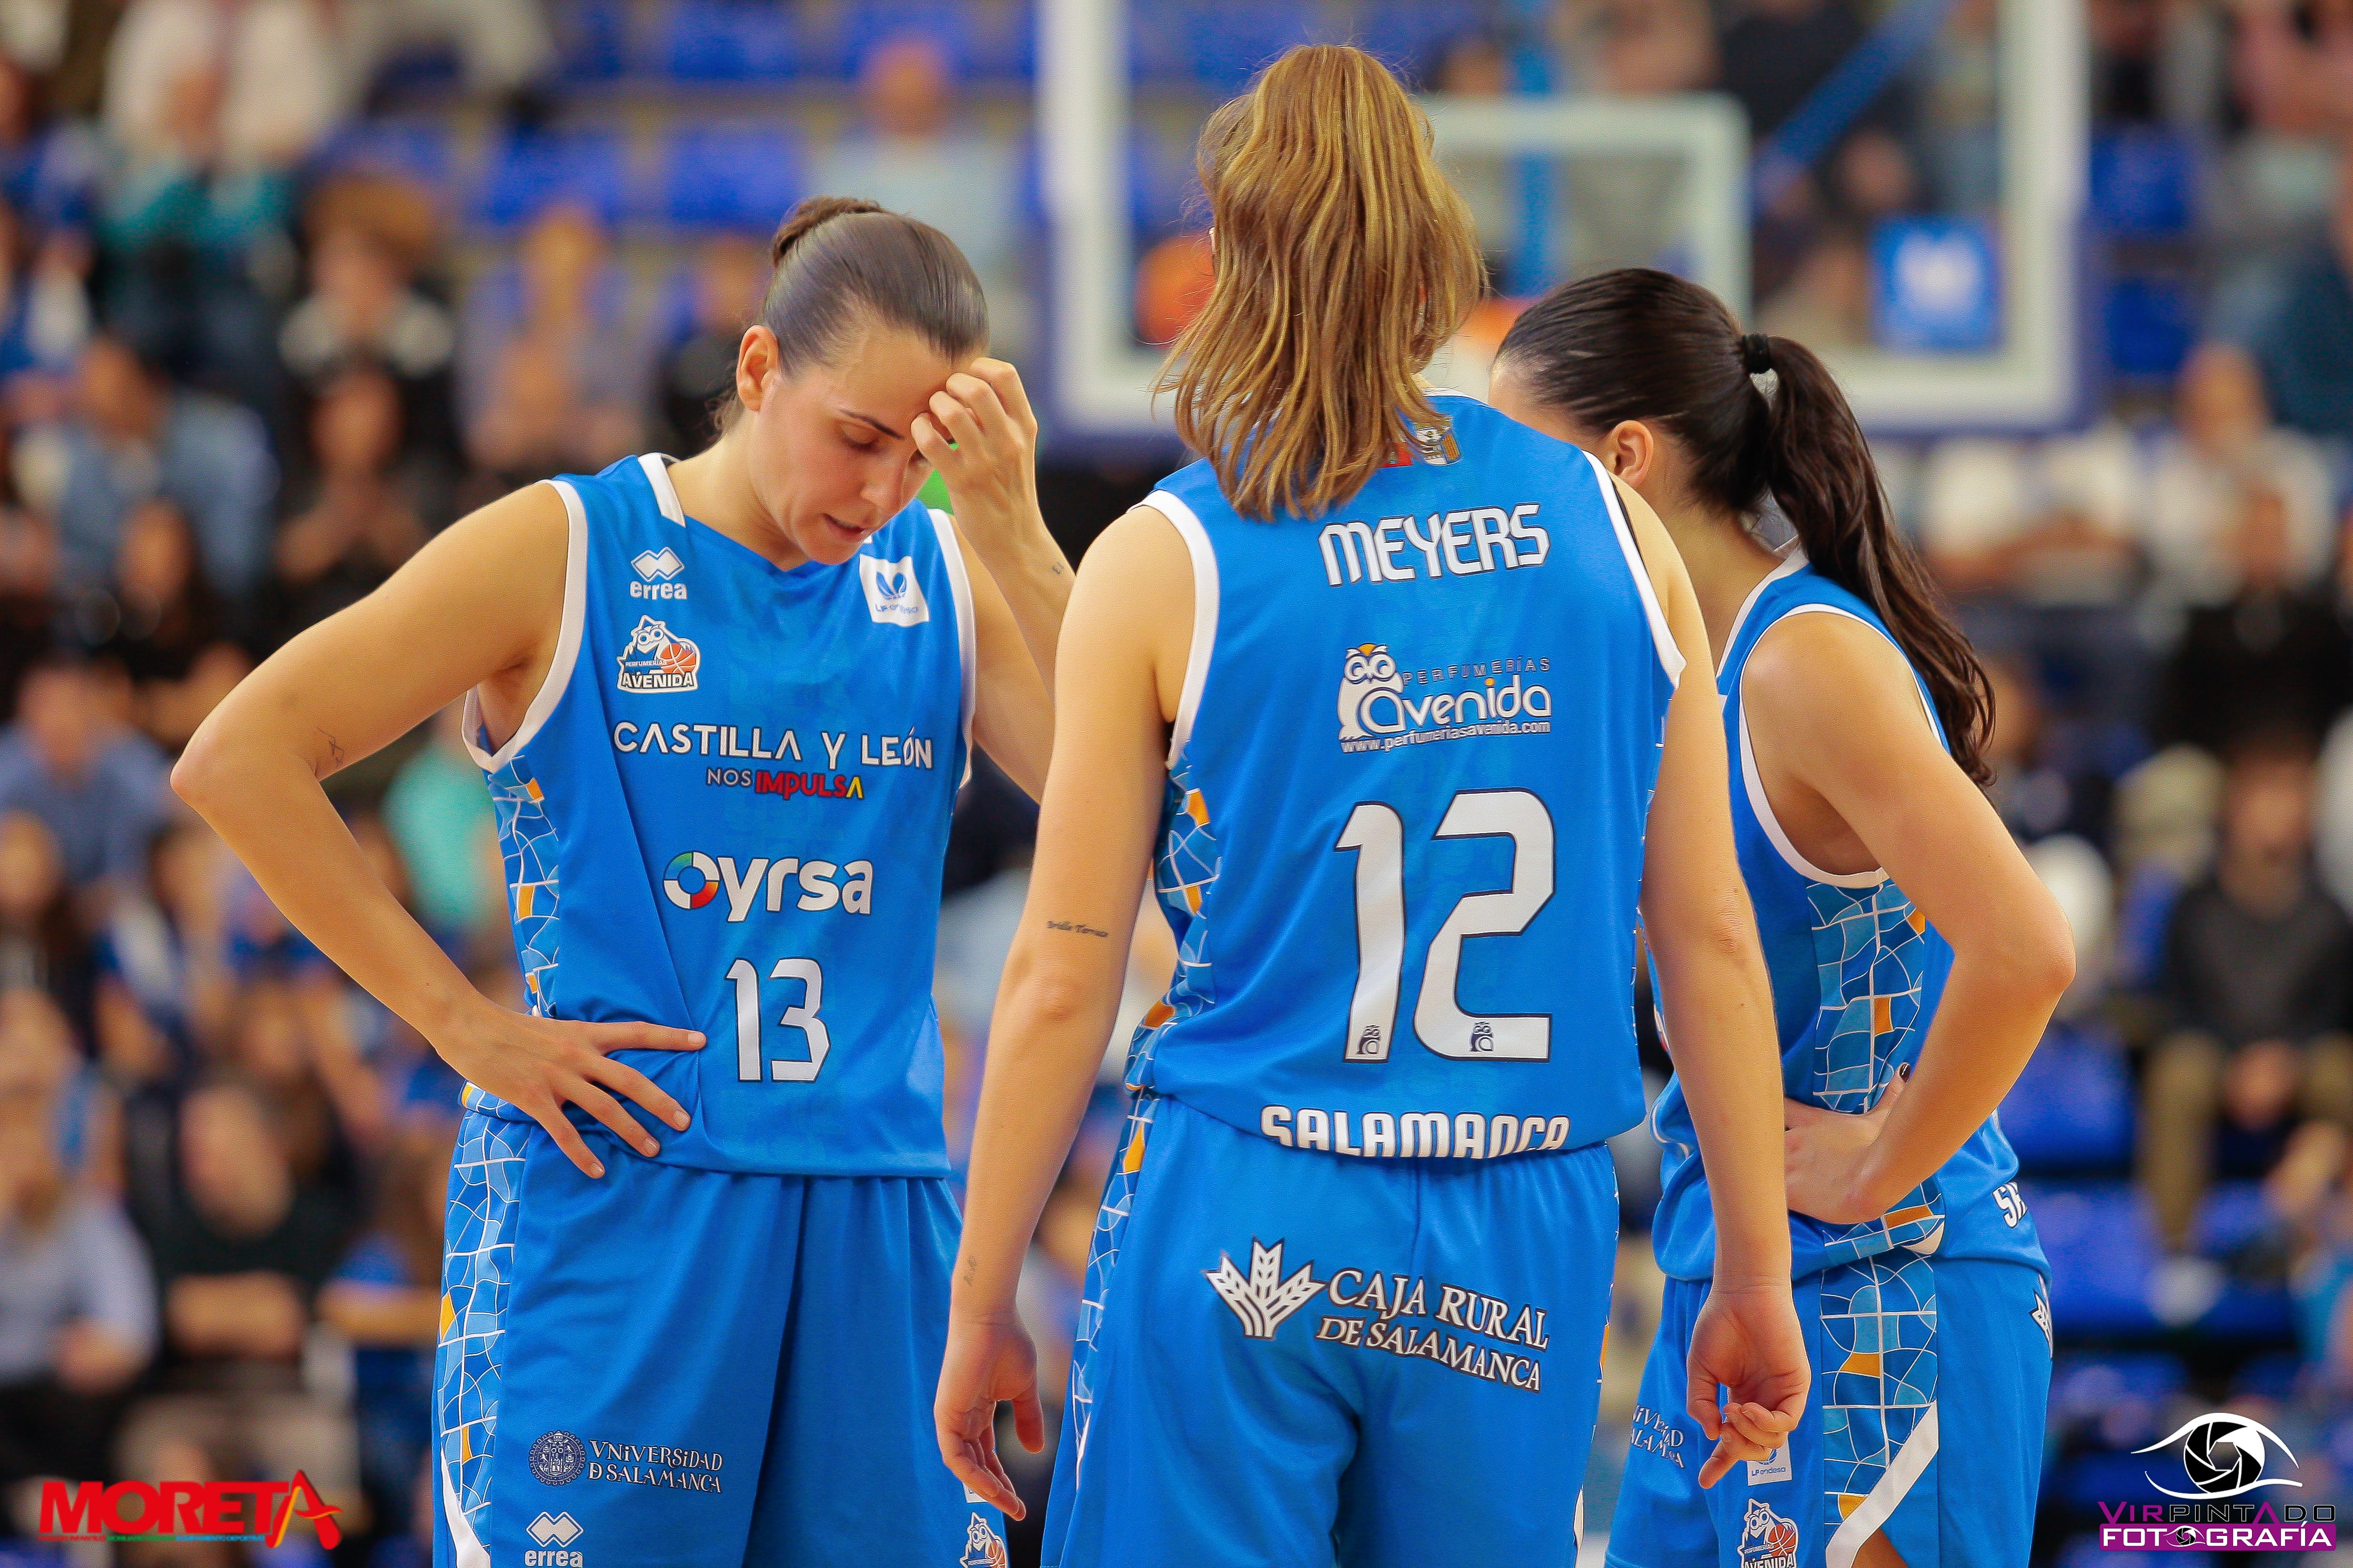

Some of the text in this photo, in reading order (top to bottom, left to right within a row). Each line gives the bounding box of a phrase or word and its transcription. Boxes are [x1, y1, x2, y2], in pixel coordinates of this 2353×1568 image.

[1318, 503, 1550, 587] MEYERS
[622, 672, 693, 688] AVENIDA
[1359, 674, 1552, 734] avenida
[614, 721, 933, 770] CASTILLA Y LEÓN
[706, 767, 863, 800] NOS IMPULSA
[663, 851, 873, 922] Oyrsa
[1334, 787, 1556, 1063] 12
[726, 958, 831, 1082] 13
[1261, 1105, 1571, 1159] SALAMANCA
[1327, 1267, 1550, 1350] CAJA RURAL
[1316, 1317, 1542, 1393] DE SALAMANCA
[605, 1463, 722, 1493] SALAMANCA
